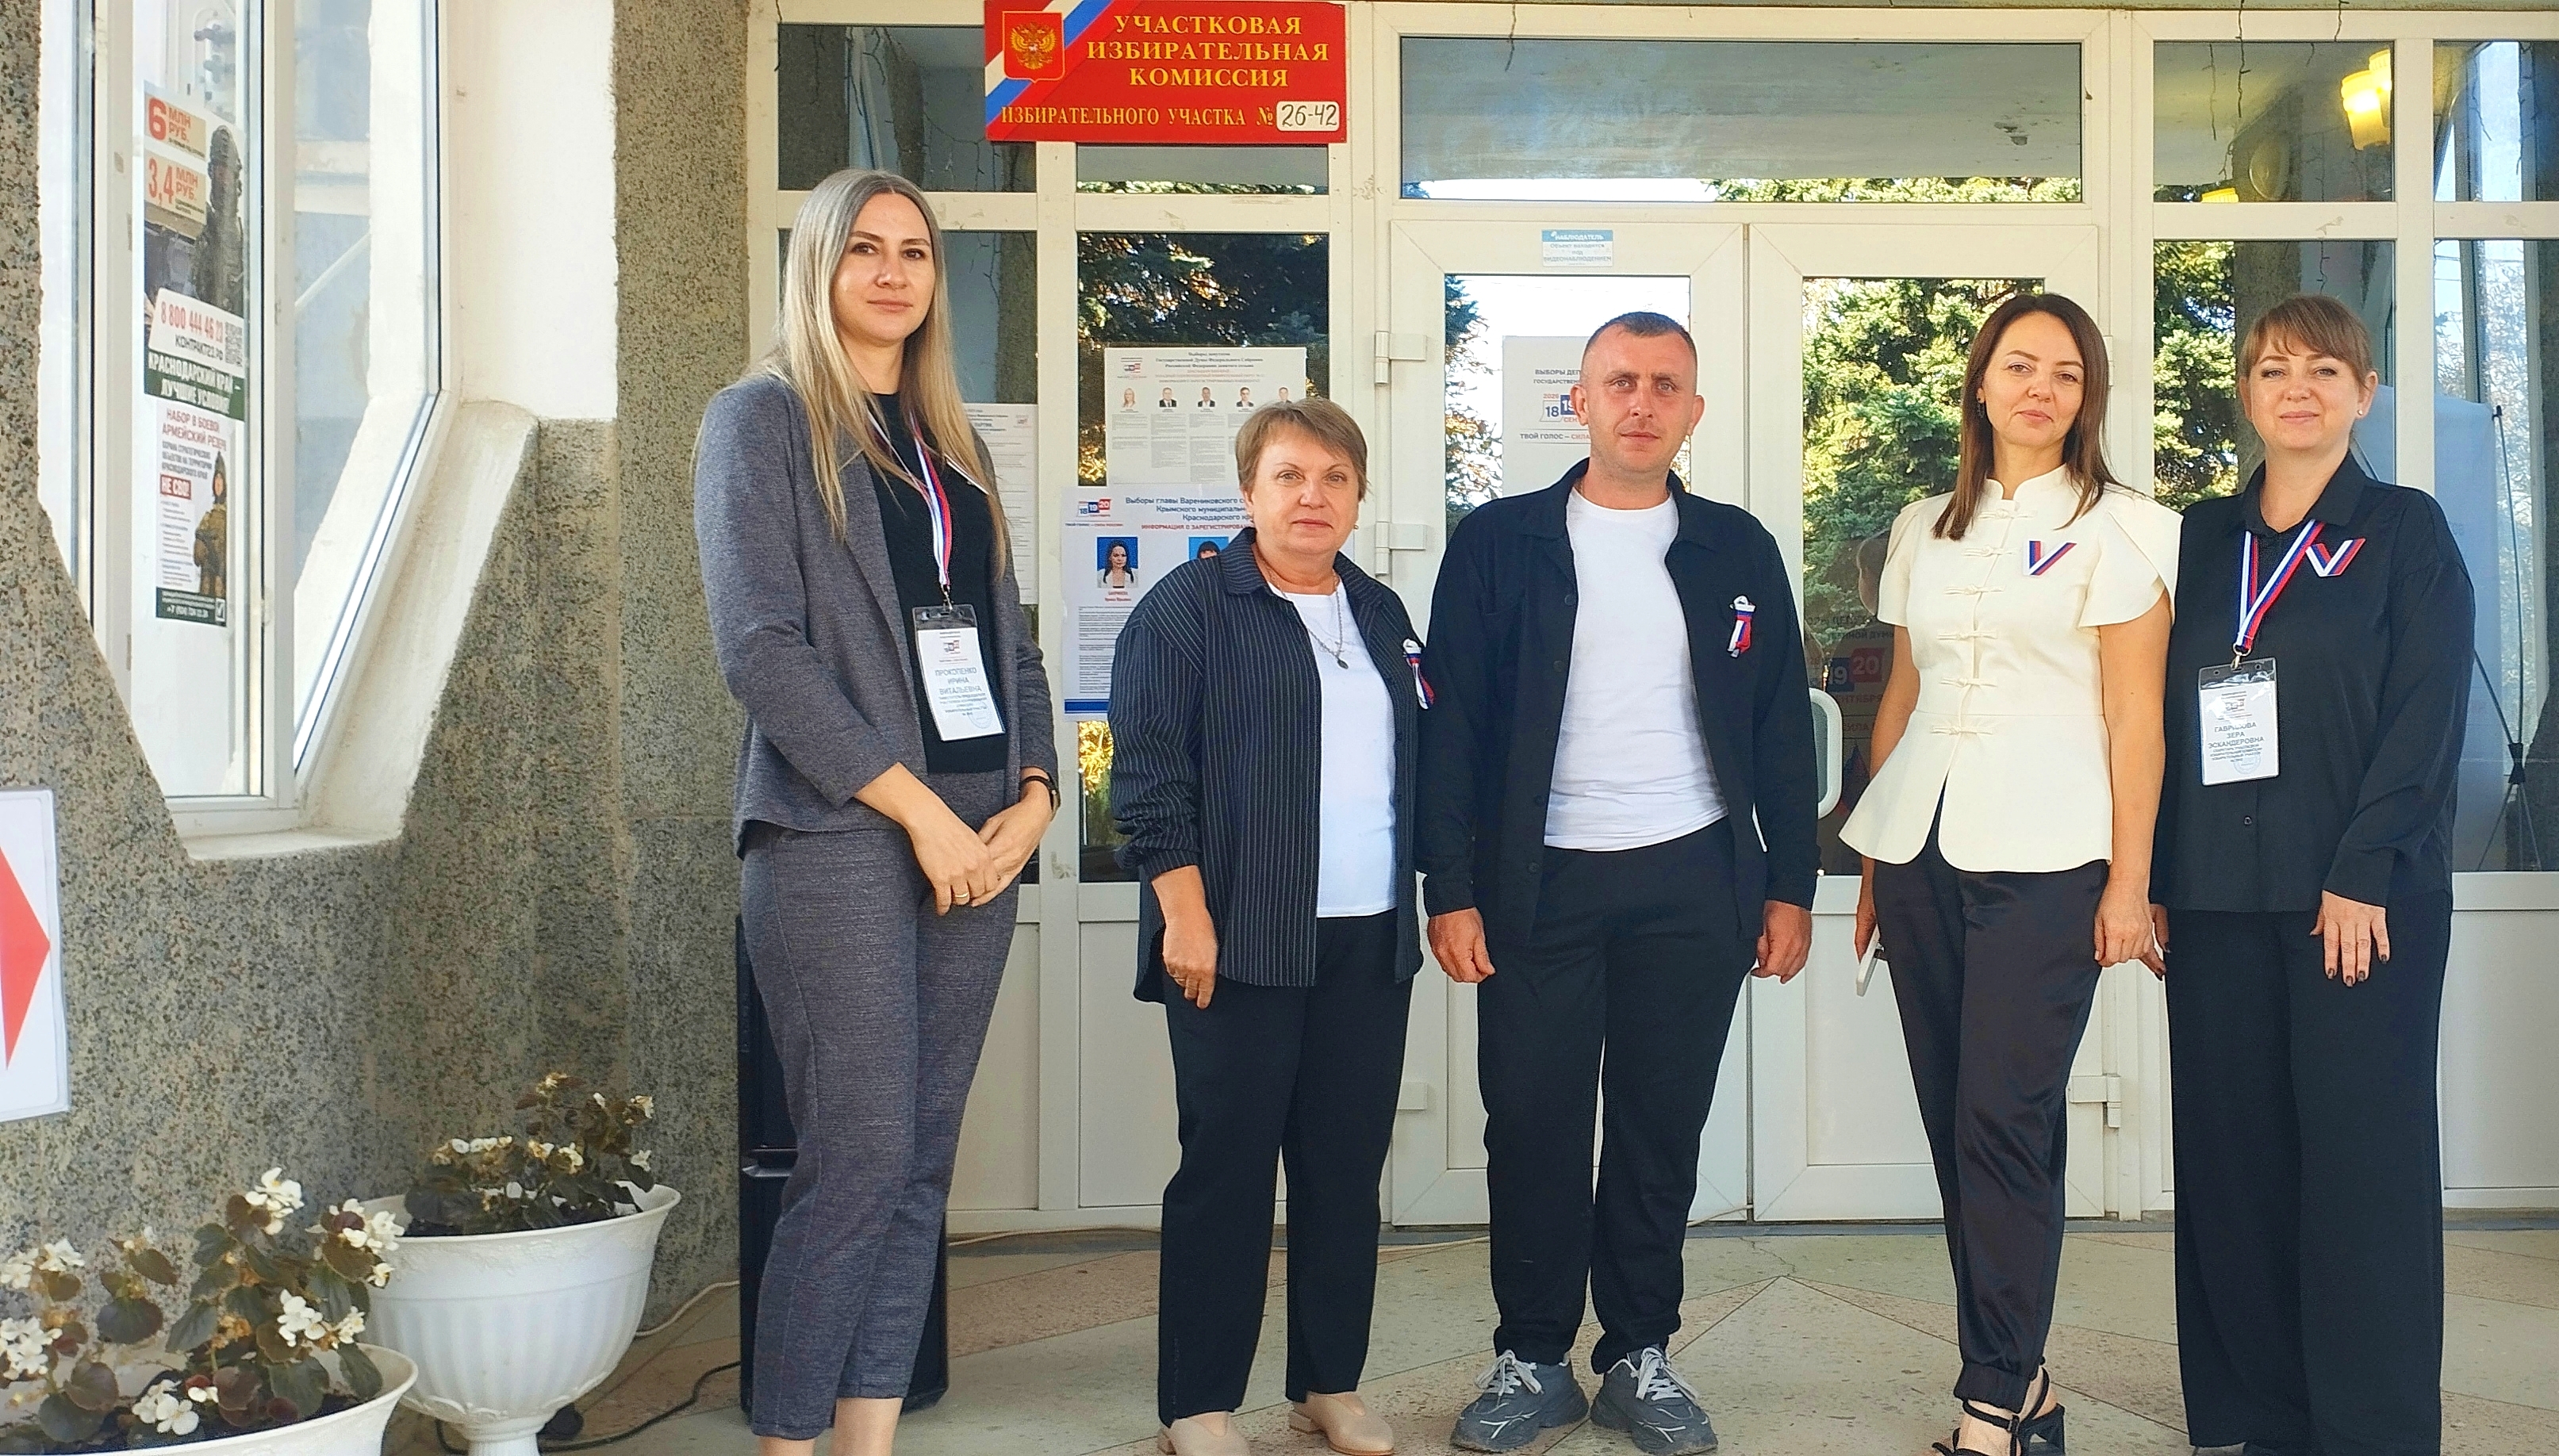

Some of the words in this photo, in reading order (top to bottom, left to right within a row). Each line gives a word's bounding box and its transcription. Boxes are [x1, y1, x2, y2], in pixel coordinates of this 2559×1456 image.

[1114, 15, 1302, 35] УЧАСТКОВАЯ
[1088, 41, 1329, 61] ИЗБИРАТЕЛЬНАЯ
[1130, 68, 1288, 87] КОМИССИЯ
[148, 98, 167, 140] 6
[169, 107, 191, 128] МЛН
[1001, 106, 1159, 125] ИЗБИРАТЕЛЬНОГО
[1168, 107, 1245, 126] УЧАСТКА
[1256, 107, 1274, 125] №
[1282, 104, 1338, 128] 26-42
[148, 158, 174, 205] 3,4
[176, 167, 198, 187] МЛН
[161, 301, 167, 324] 8
[169, 304, 186, 329] 800
[1545, 406, 1559, 417] 18
[1853, 656, 1881, 675] 20
